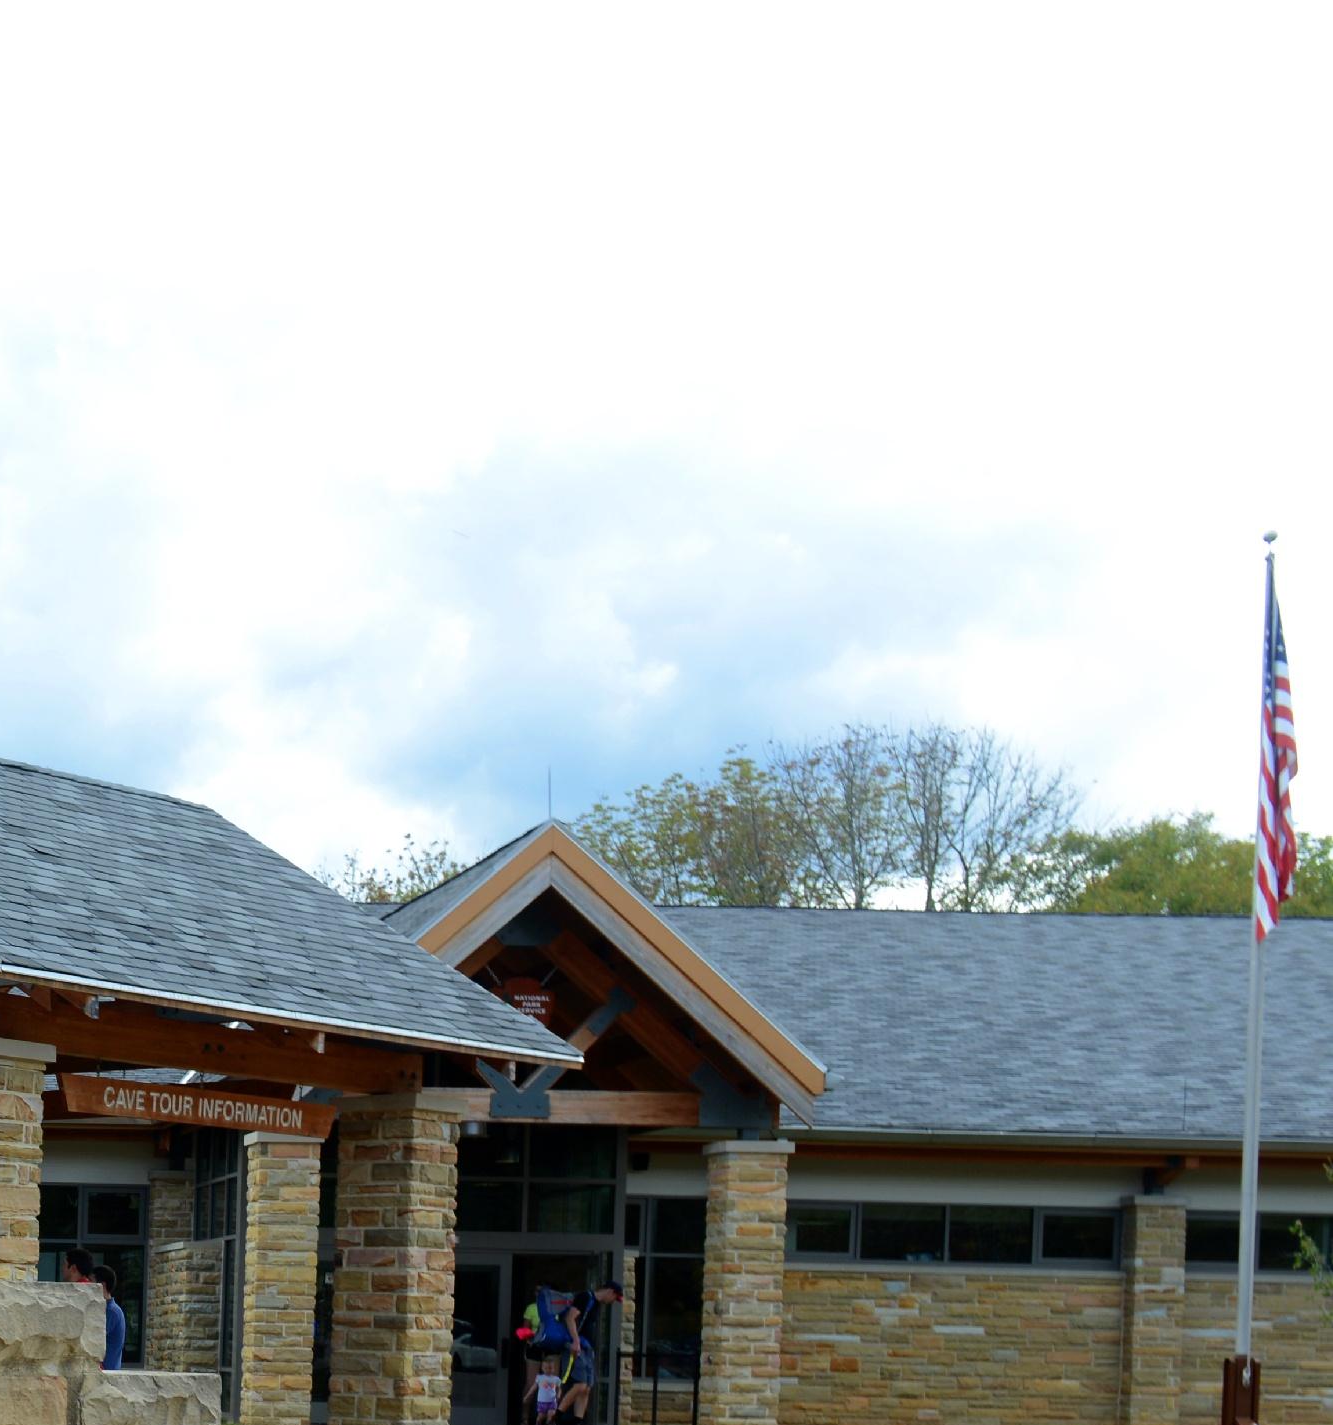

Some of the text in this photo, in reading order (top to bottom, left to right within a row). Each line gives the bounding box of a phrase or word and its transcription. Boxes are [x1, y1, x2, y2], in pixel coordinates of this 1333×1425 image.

[103, 1086, 303, 1128] CAVE TOUR INFORMATION
